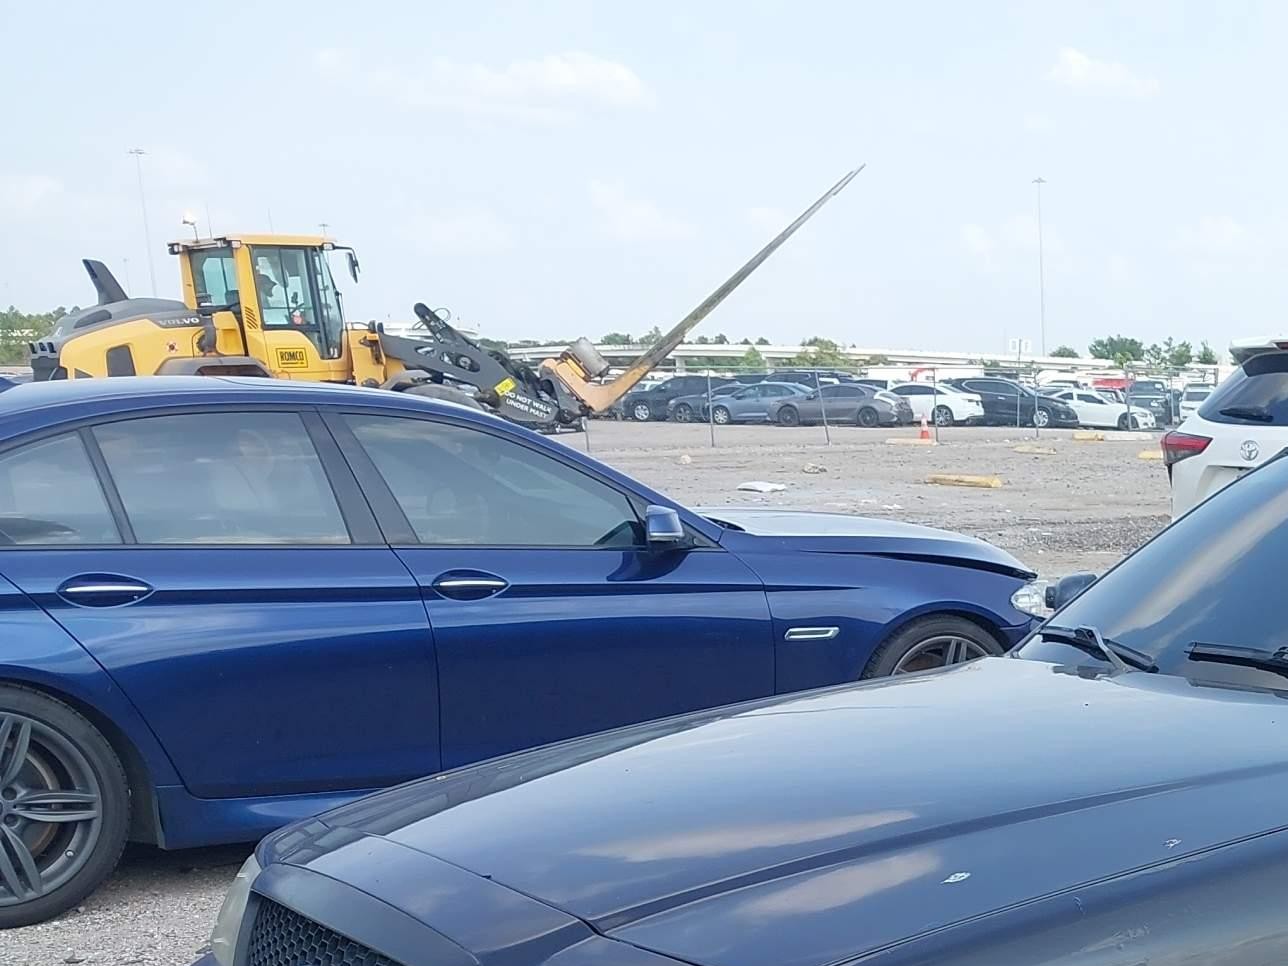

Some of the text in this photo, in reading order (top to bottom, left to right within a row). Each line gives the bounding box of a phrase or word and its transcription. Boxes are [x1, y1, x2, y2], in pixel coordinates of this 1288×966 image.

[158, 317, 199, 326] VOLVO
[280, 351, 304, 361] ROMCO
[505, 391, 552, 414] DO NOT WALK
[506, 398, 529, 412] UNDER
